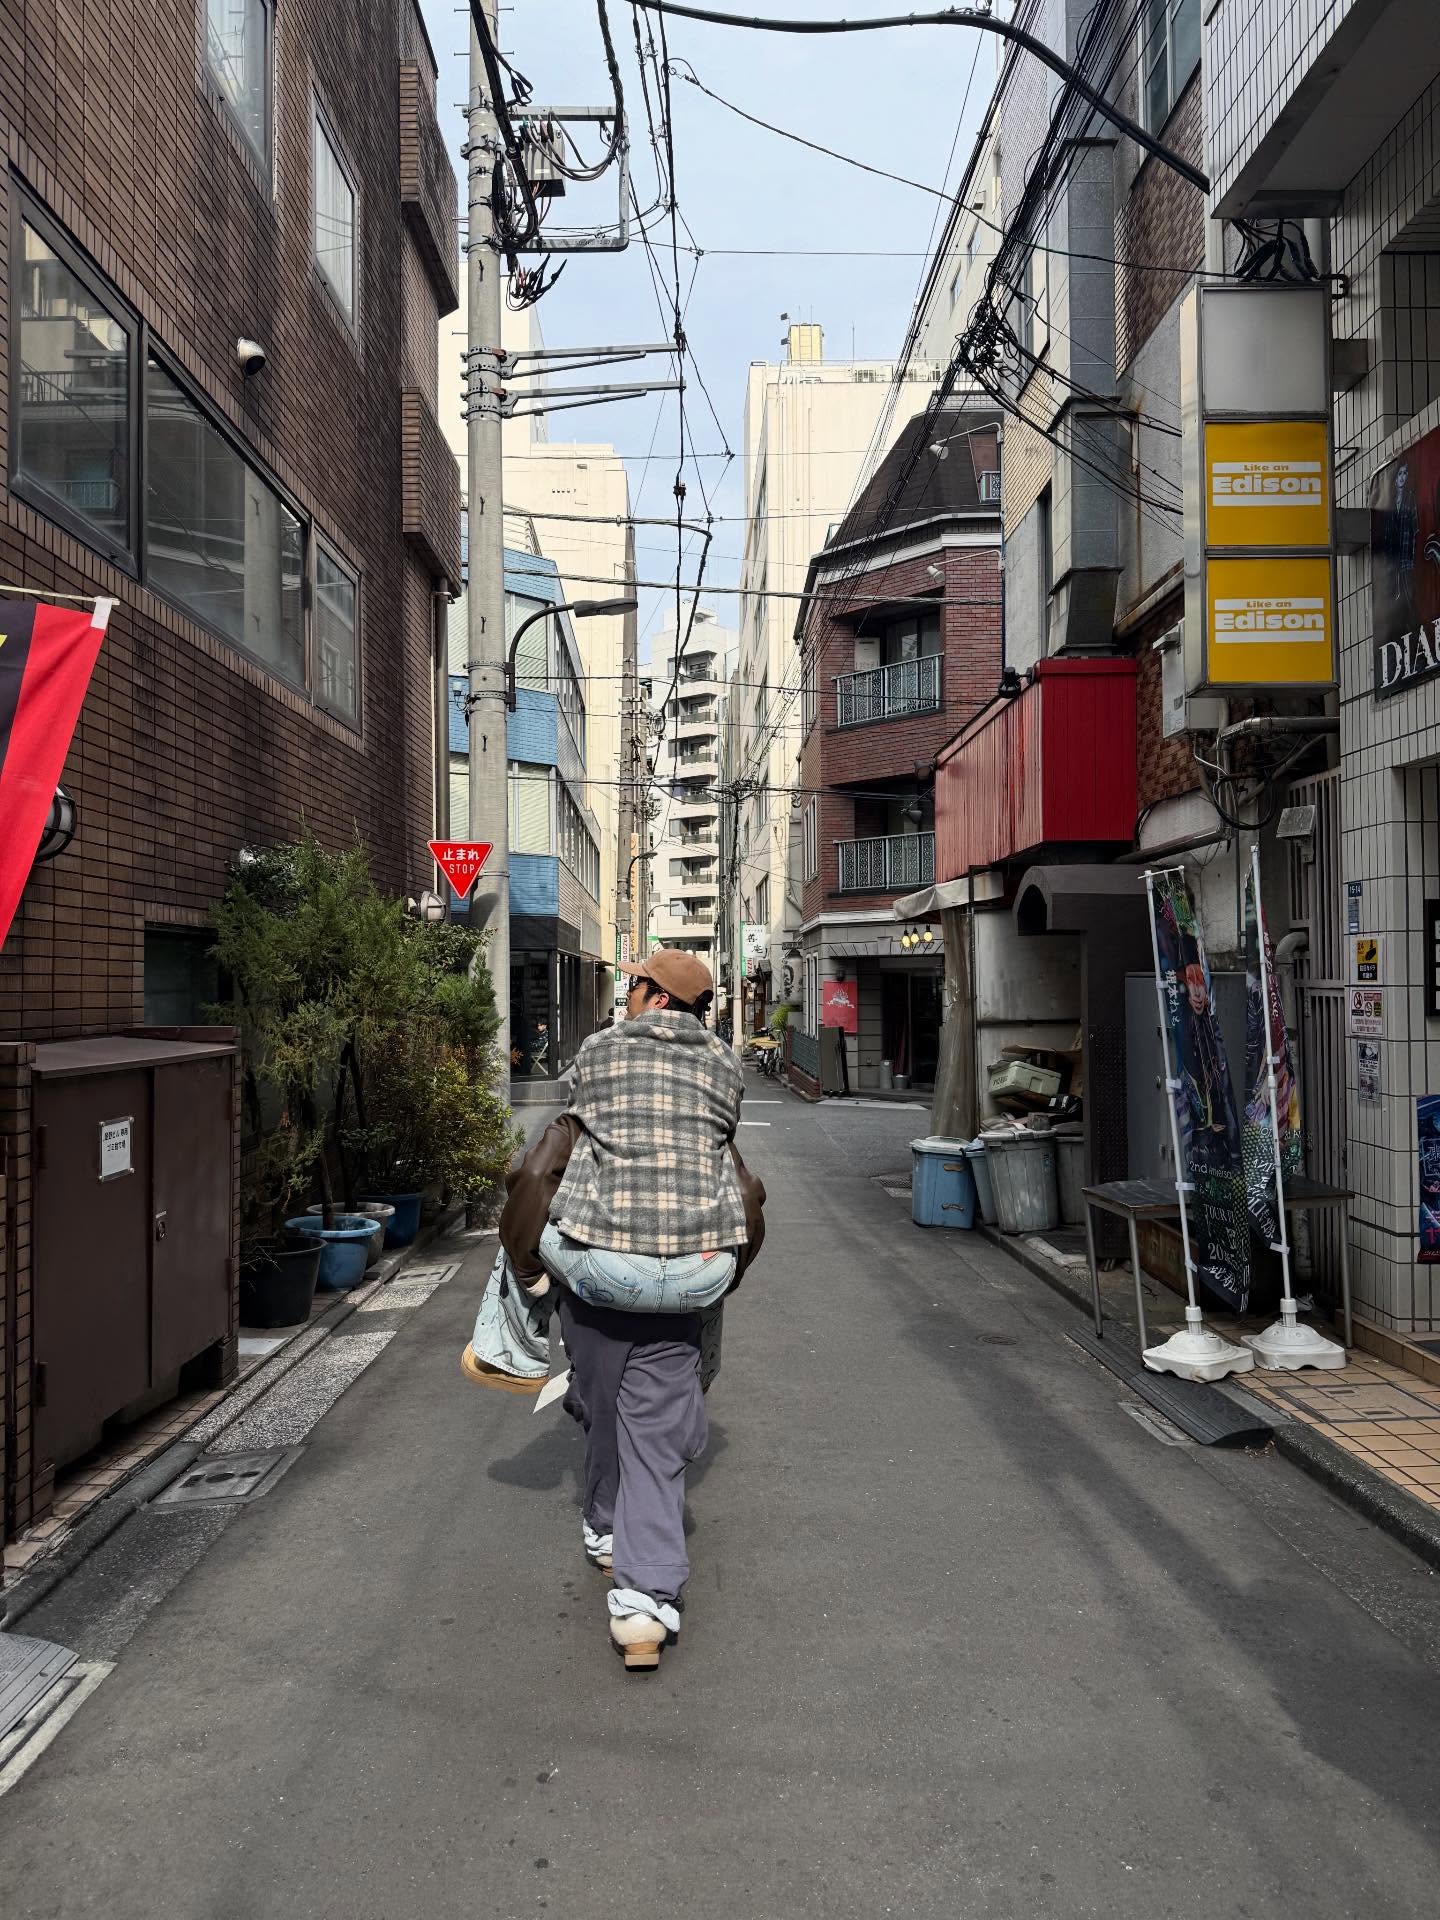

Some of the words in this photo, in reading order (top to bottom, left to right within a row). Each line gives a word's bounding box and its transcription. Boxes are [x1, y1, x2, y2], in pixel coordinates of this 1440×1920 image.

[1243, 463, 1269, 471] Like
[1212, 474, 1321, 493] Edison
[1246, 600, 1272, 608] Like
[1215, 610, 1325, 630] Edison
[441, 847, 480, 861] 止まれ
[449, 863, 475, 875] STOP
